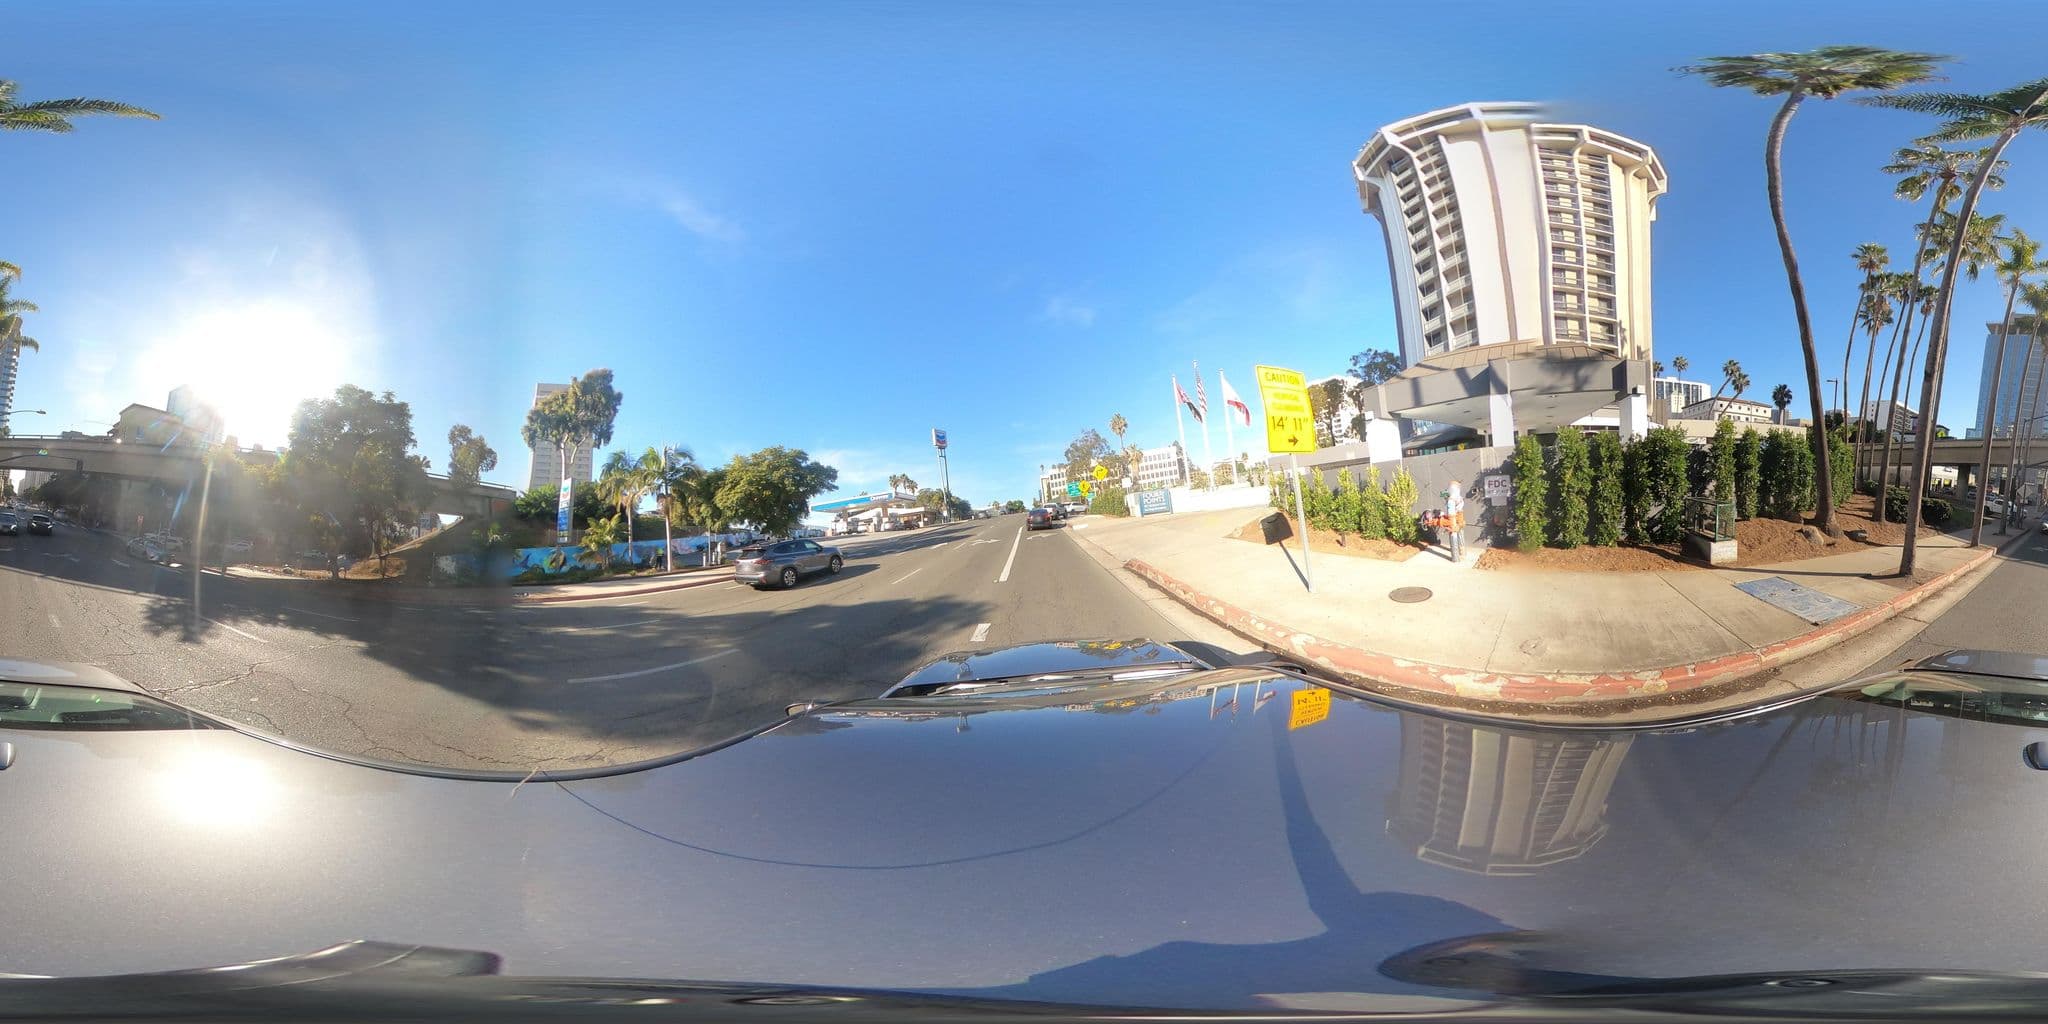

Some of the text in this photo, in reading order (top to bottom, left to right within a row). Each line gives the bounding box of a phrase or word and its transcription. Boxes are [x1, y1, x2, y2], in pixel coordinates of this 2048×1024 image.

[1265, 373, 1299, 385] CAUTION
[1272, 415, 1288, 430] 14'
[1488, 480, 1507, 488] FDC
